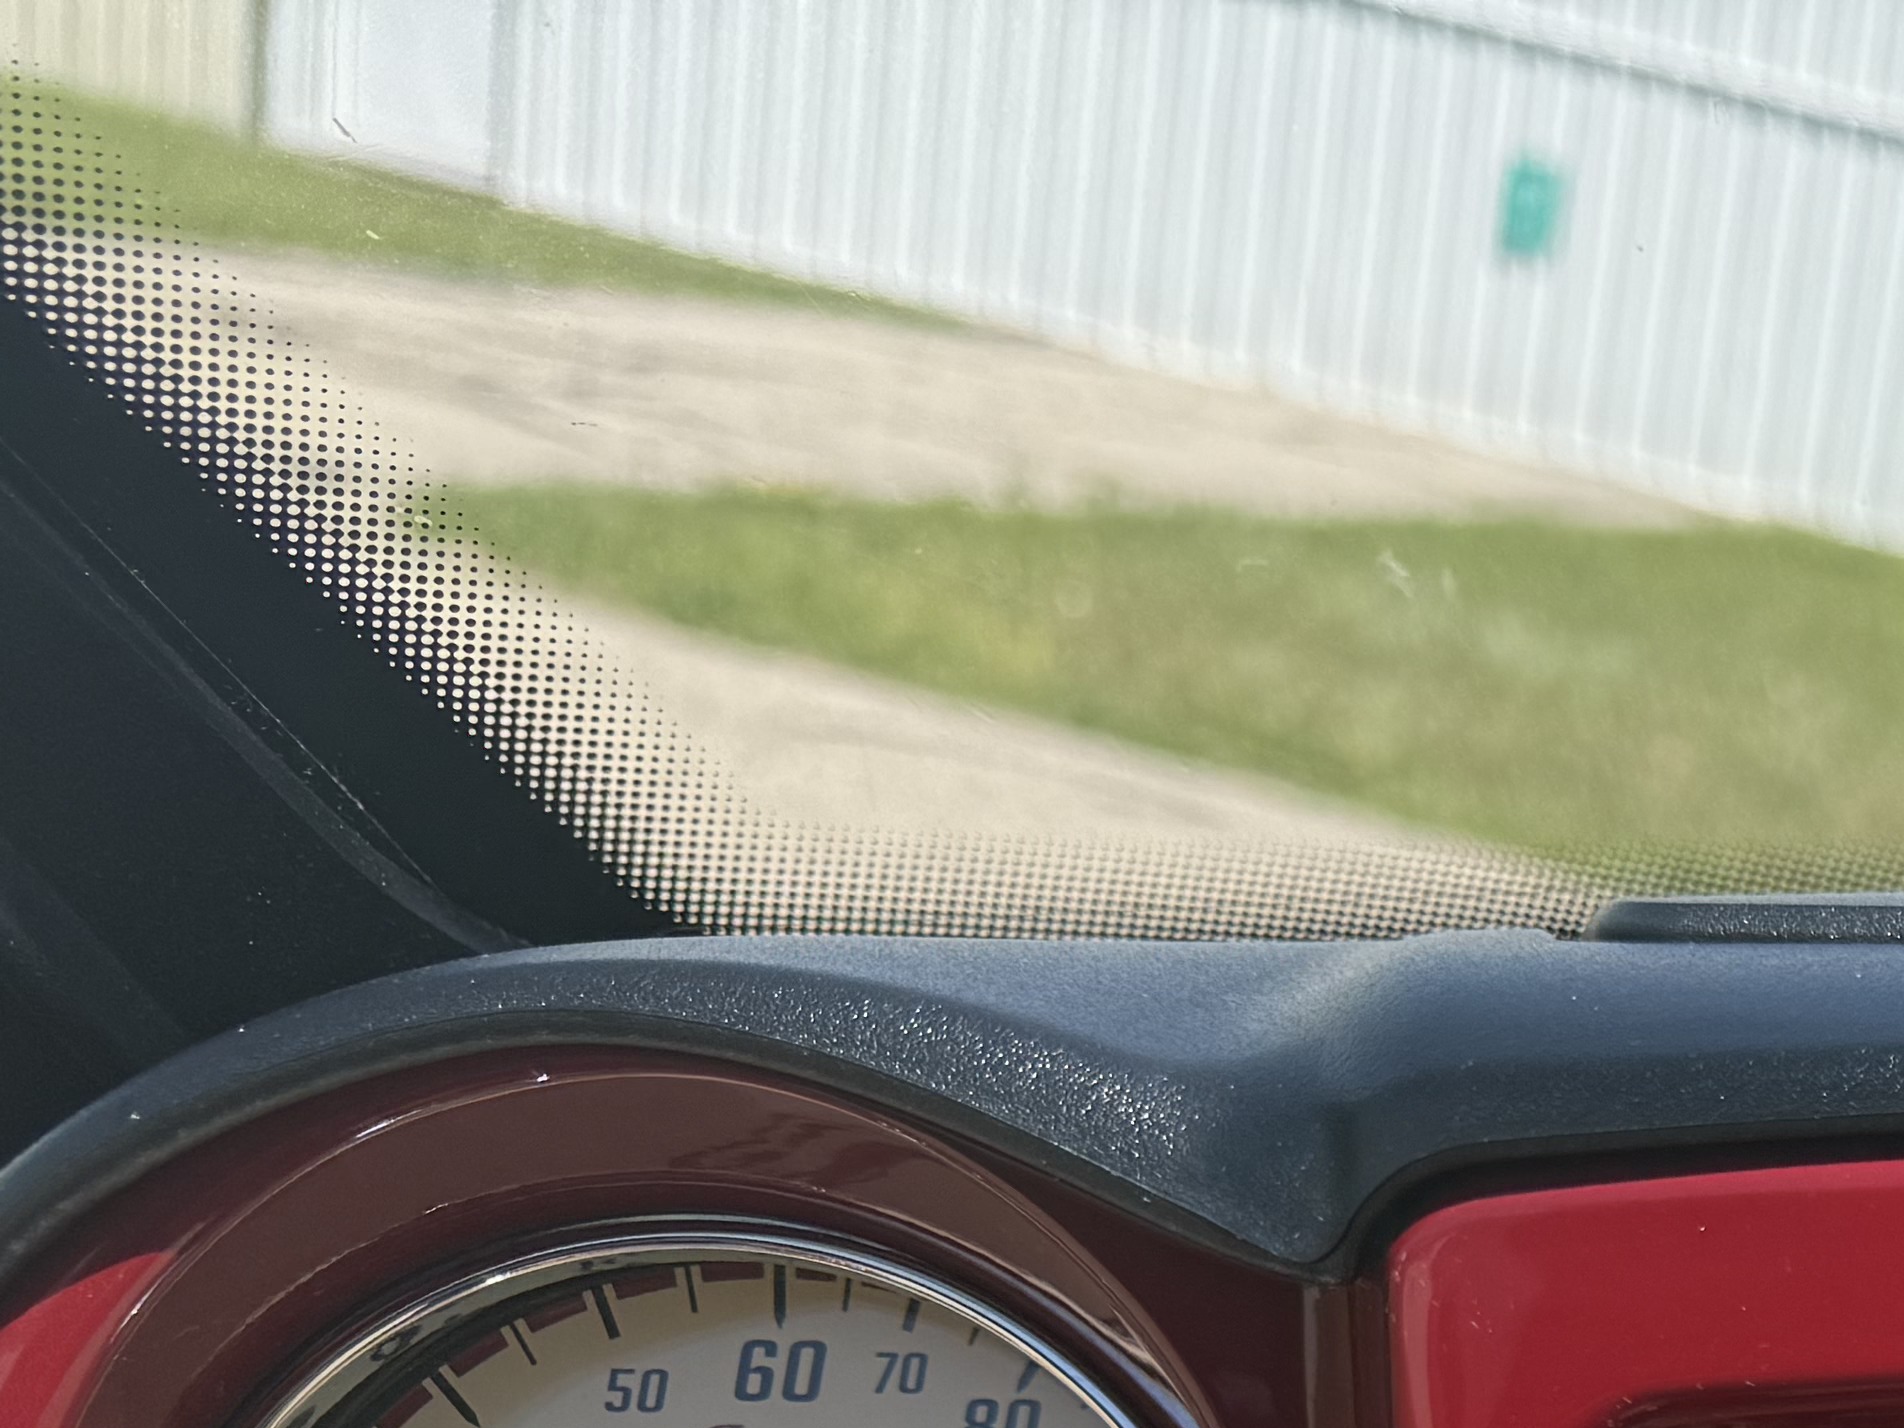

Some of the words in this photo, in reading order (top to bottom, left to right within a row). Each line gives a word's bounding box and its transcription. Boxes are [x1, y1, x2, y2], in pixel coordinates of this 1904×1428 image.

[604, 1368, 668, 1413] 50
[735, 1339, 828, 1403] 60
[873, 1352, 928, 1395] 70
